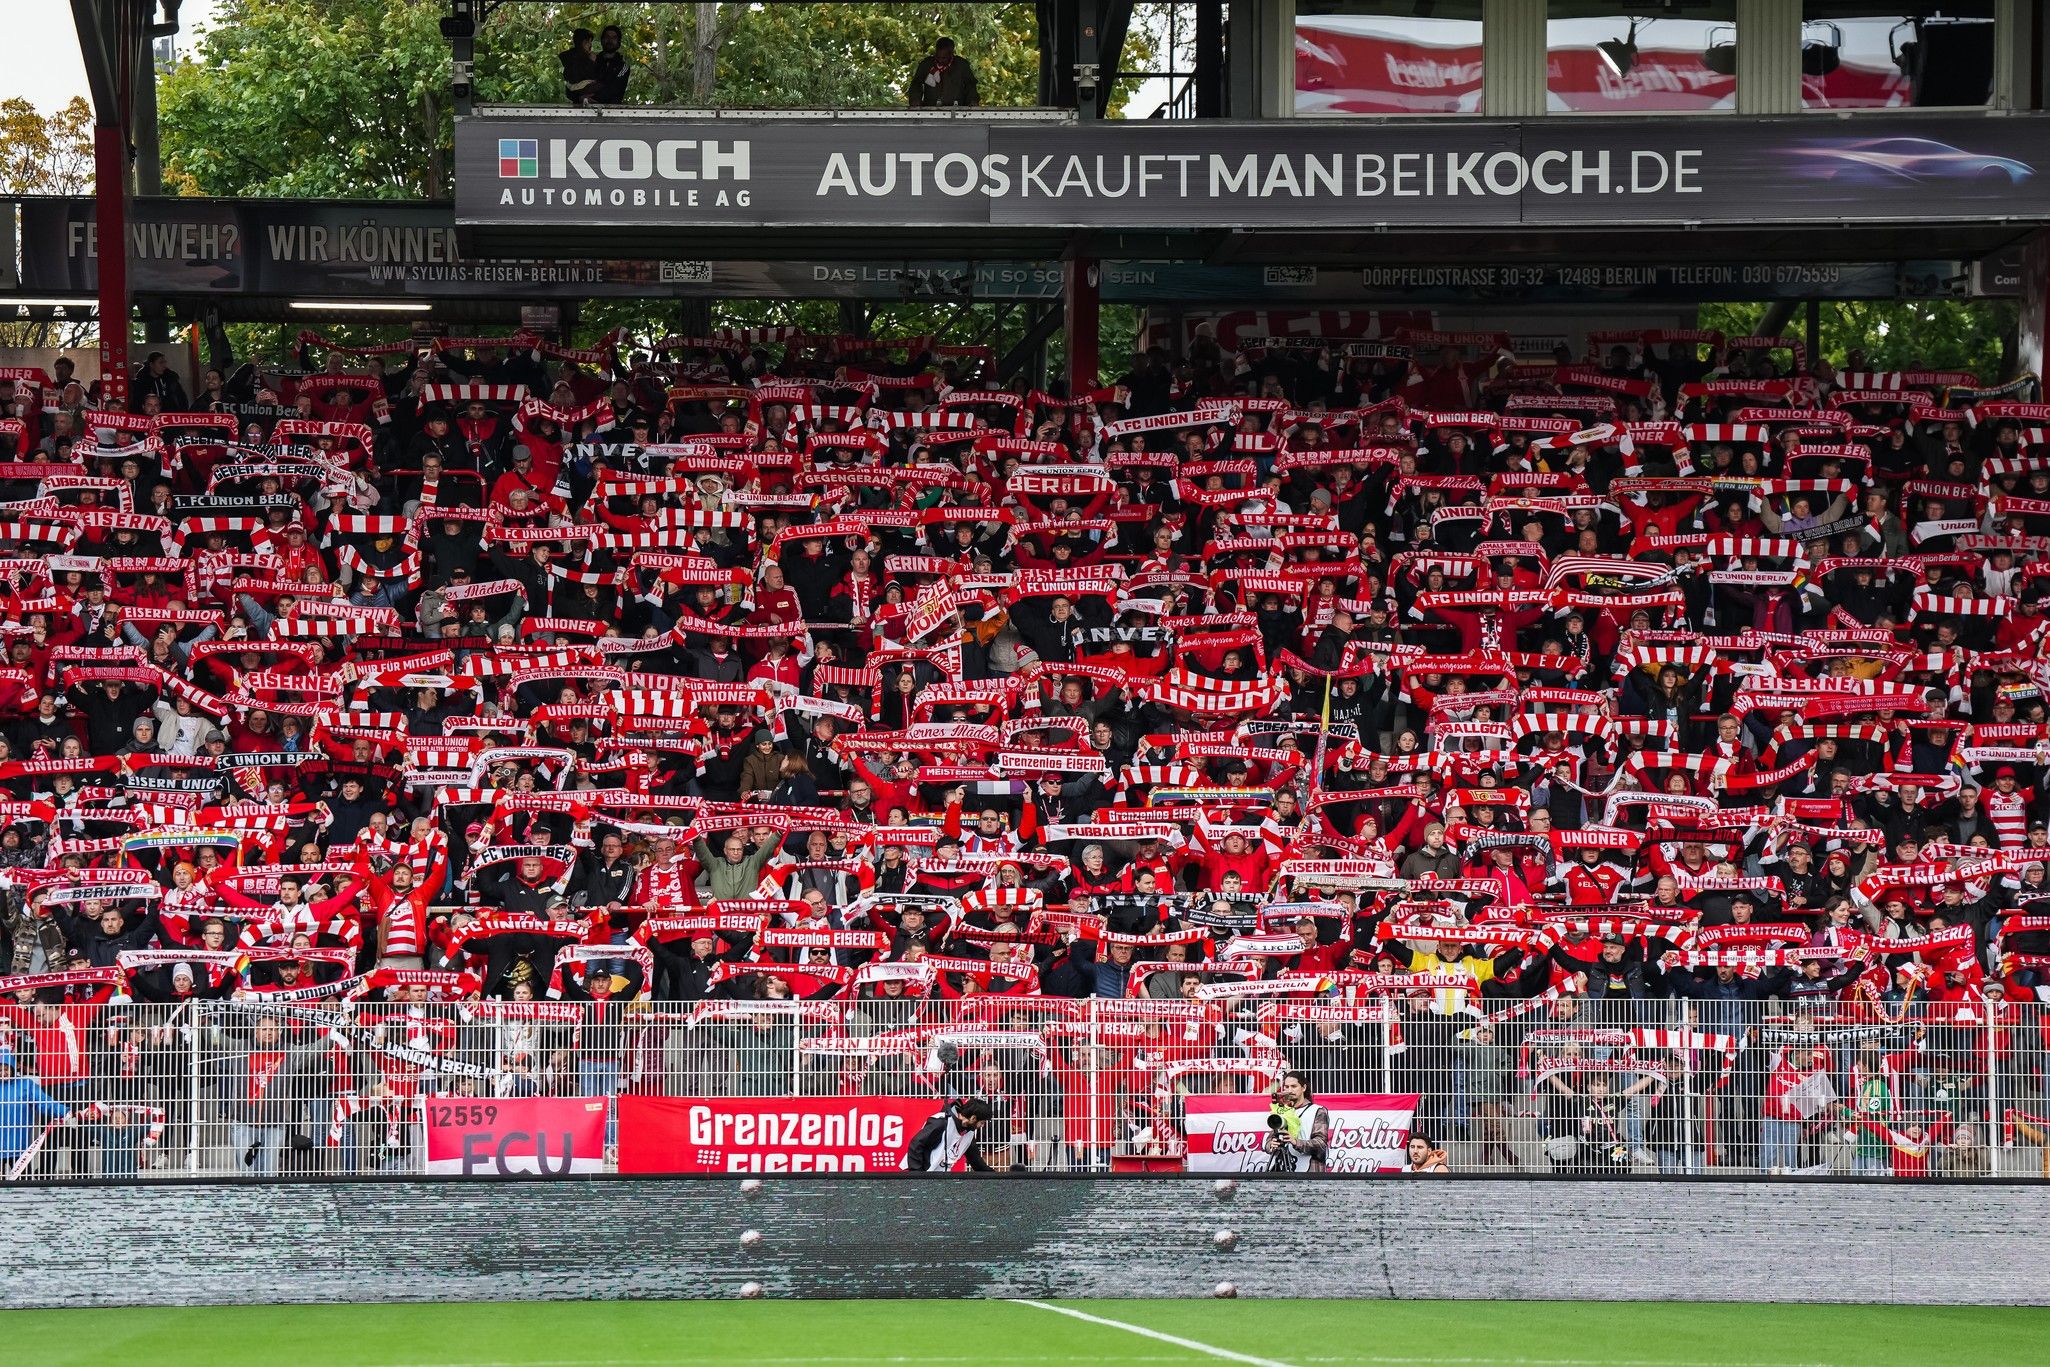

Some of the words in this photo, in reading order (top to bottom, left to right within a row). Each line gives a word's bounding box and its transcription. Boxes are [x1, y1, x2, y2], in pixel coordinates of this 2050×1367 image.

[550, 140, 750, 180] KOCH
[500, 190, 699, 207] AUTOMOBILE
[715, 190, 752, 208] AG
[68, 221, 238, 260] FENWEH?
[268, 224, 328, 262] WIR
[370, 264, 603, 283] WWW.SYLVIAS-REISEN-BERLIN.DE
[813, 265, 857, 280] DAS
[1001, 267, 1029, 281] SO
[1110, 271, 1156, 284] SEIN
[1363, 267, 1496, 288] DÖRPFELDSTRASSE
[1500, 268, 1544, 286] 30-32
[1557, 268, 1601, 286] 12489
[1606, 268, 1657, 286] BERLIN
[1671, 267, 1737, 284] TELEFON:
[1742, 266, 1772, 284] 030
[1776, 266, 1840, 284] 6775539
[1351, 344, 1383, 356] UNION
[318, 376, 336, 389] FÜR
[1570, 372, 1628, 391] UNIONER
[1706, 380, 1766, 391] UNIONER
[755, 387, 804, 401] UNIONER
[1038, 392, 1094, 406] UNIONER
[1862, 390, 1898, 400] Union
[240, 404, 273, 415] Union
[1749, 409, 1764, 420] FC
[1766, 409, 1808, 420] UNION
[1999, 405, 2016, 416] FC
[172, 414, 207, 425] Union
[1145, 414, 1189, 429] UNION
[1436, 412, 1468, 424] UNION
[1530, 419, 1571, 431] UNION
[689, 436, 743, 445] COMBINAT
[811, 432, 867, 448] UNIONER
[947, 430, 981, 441] Union
[997, 438, 1057, 452] UNIONER
[1800, 444, 1841, 456] UNION
[688, 456, 745, 470] UNIONER
[736, 453, 793, 466] UNIONER
[214, 464, 255, 479] GEGEN
[277, 464, 325, 479] GERADE
[1046, 466, 1075, 475] UNION
[1502, 472, 1559, 485] UNIONER
[1913, 483, 1949, 496] UNION
[184, 495, 200, 507] FC
[203, 494, 255, 506] UNION
[746, 493, 770, 502] UNION
[772, 494, 807, 502] BERLIN
[944, 508, 1000, 519] UNIONER
[505, 527, 518, 539] FC
[521, 527, 563, 539] UNION
[1650, 533, 1707, 546] UNIONER
[639, 554, 683, 568] UNION
[1847, 557, 1883, 567] UNION
[682, 568, 732, 581] UNIONER
[1147, 573, 1168, 583] EISERN
[1170, 574, 1191, 583] UNION
[1724, 573, 1753, 583] UNION
[1755, 573, 1789, 583] BERLIN
[271, 581, 333, 594] MITGLIEDER!
[1027, 582, 1041, 594] FC
[1042, 581, 1080, 593] UNION
[1244, 578, 1304, 593] UNIONER
[1453, 591, 1505, 604] UNION
[125, 607, 172, 619] EISERN
[176, 608, 224, 621] UNION
[535, 617, 597, 633] UNIONER
[1806, 630, 1847, 642] EISERN
[1849, 629, 1892, 642] UNION
[199, 642, 307, 655] GEGENGERADE
[356, 662, 379, 675] NUR
[1045, 661, 1066, 674] FÜR
[691, 690, 756, 703] UNIONER
[1540, 688, 1602, 703] MITGLIEDER
[1845, 698, 1873, 709] UNION
[546, 705, 609, 718] UNIONER
[632, 717, 691, 730] UNIONER
[1171, 731, 1225, 743] UNIONER
[1979, 724, 2037, 737] UNIONER
[444, 737, 470, 747] UNION
[602, 737, 616, 749] FC
[617, 737, 653, 749] UNION
[655, 738, 695, 751] BERLIN
[150, 752, 213, 766] UNIONER
[234, 754, 283, 766] UNION
[1251, 746, 1291, 761] EISERN
[1976, 749, 1986, 758] FC
[1988, 749, 2016, 758] UNION
[22, 757, 95, 773] UNIONER
[1002, 754, 1063, 768] Grenzenlos
[1066, 756, 1105, 772] EISERN
[1755, 757, 1808, 787] UNIONER
[127, 776, 177, 790] EISERN
[603, 792, 651, 805] EISERN
[654, 794, 703, 807] UNION
[1317, 791, 1337, 801] FC
[1339, 788, 1383, 800] Union
[221, 804, 289, 818] UNIONER
[504, 799, 571, 813] UNIONER
[1108, 808, 1170, 823] Grenzenlos
[146, 836, 179, 846] EISERN
[181, 835, 219, 845] UNION
[1560, 831, 1628, 846] UNIONER
[501, 846, 542, 857] UNION
[1286, 861, 1330, 874] EISERN
[1334, 859, 1376, 873] UNION
[1904, 869, 1957, 885] UNION
[1959, 858, 2016, 879] BERLIN
[72, 886, 131, 898] BERLIN
[717, 900, 789, 911] UNIONER
[464, 923, 483, 936] FC
[487, 919, 548, 932] UNION
[649, 917, 716, 931] Grenzenlos
[719, 915, 762, 930] EISERN
[764, 931, 828, 946] Grenzenlos
[833, 931, 876, 945] EISERN
[1871, 936, 1888, 949] FC
[1890, 933, 1931, 949] UNION
[136, 953, 152, 961] FC
[153, 952, 190, 962] UNION
[192, 953, 230, 963] BERLIN
[990, 961, 1032, 979] EISERN
[1149, 963, 1164, 972] FC
[1167, 962, 1204, 971] UNION
[396, 970, 459, 985] UNIONER
[1366, 974, 1416, 990] EISERN
[1419, 973, 1469, 986] UNION
[272, 990, 293, 1001] FC
[295, 984, 339, 999] UNION
[430, 1106, 497, 1128] 12559
[690, 1106, 904, 1147] Grenzenlos
[1212, 1121, 1258, 1153] love
[1330, 1118, 1404, 1149] berlin
[462, 1132, 574, 1175] FCU
